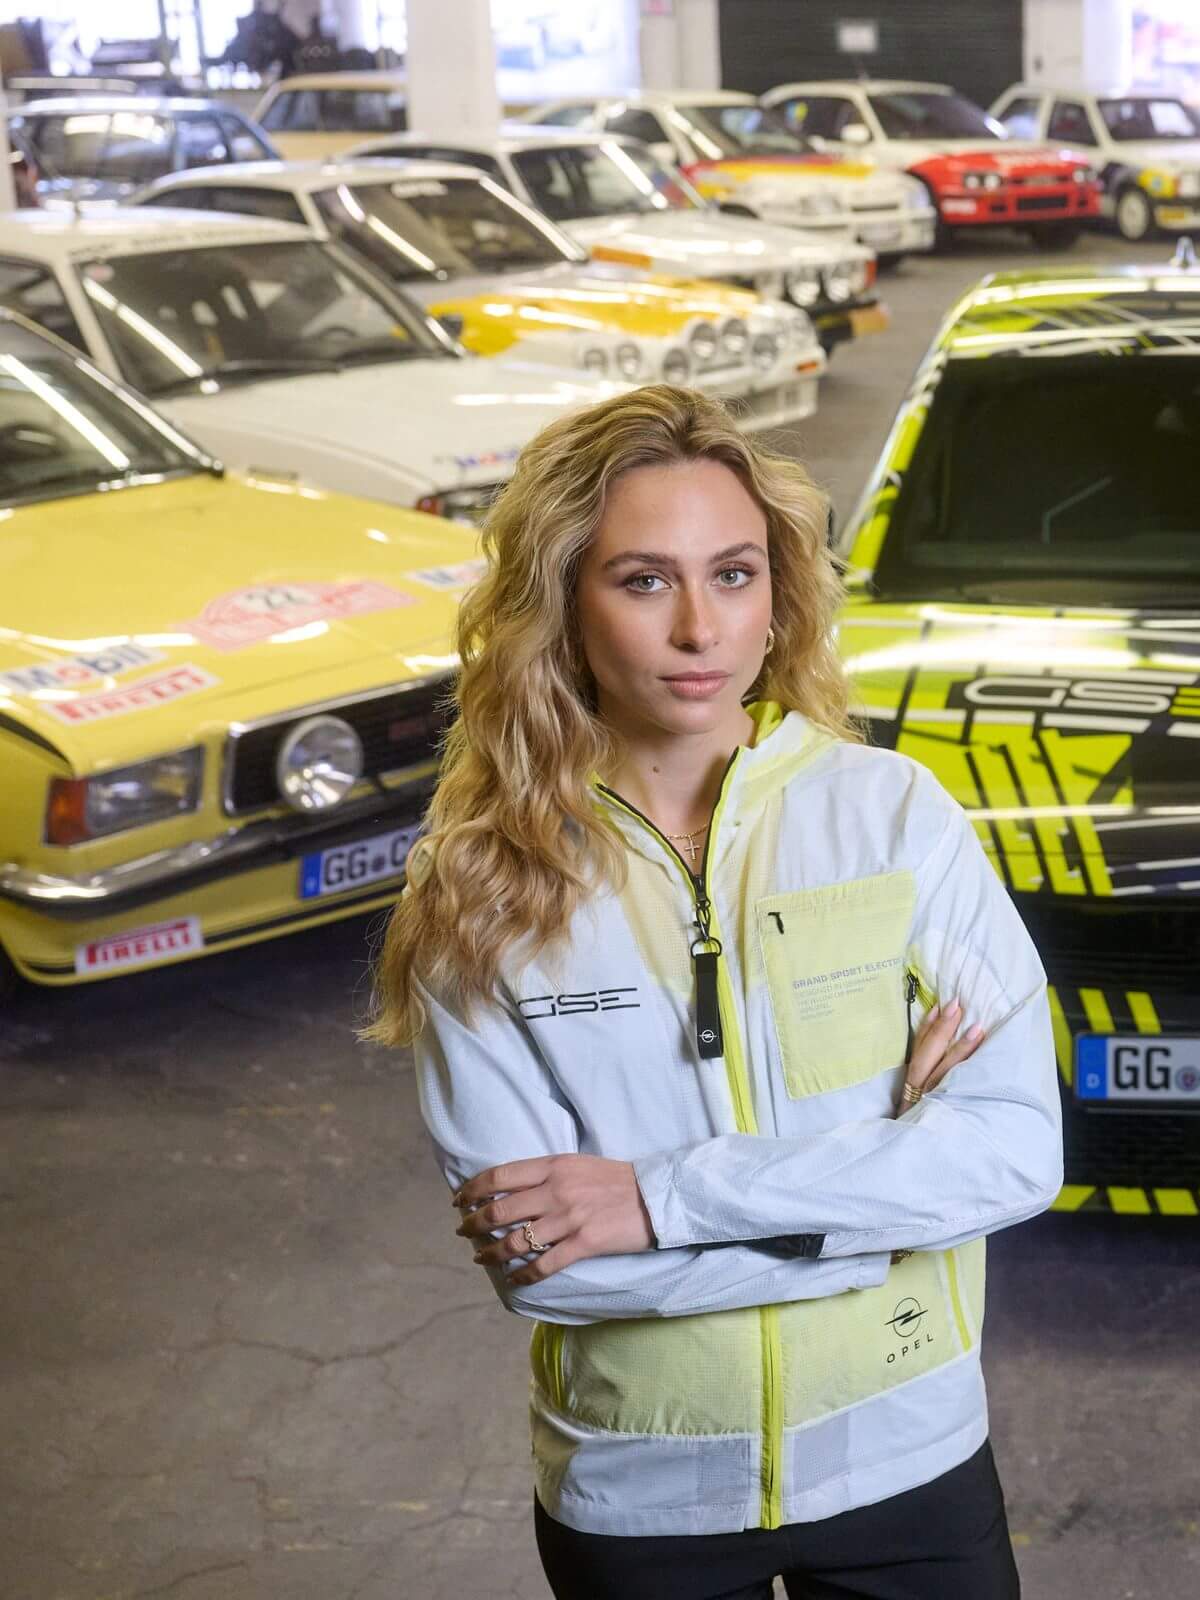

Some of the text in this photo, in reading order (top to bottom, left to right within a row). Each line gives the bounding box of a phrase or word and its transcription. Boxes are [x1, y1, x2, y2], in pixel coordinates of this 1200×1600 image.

[54, 668, 206, 720] PIRELLI
[324, 846, 368, 886] GG
[86, 921, 190, 966] PIRELLI
[518, 987, 641, 1020] GSE
[1113, 1046, 1171, 1090] GG
[886, 1333, 934, 1364] OPEL
